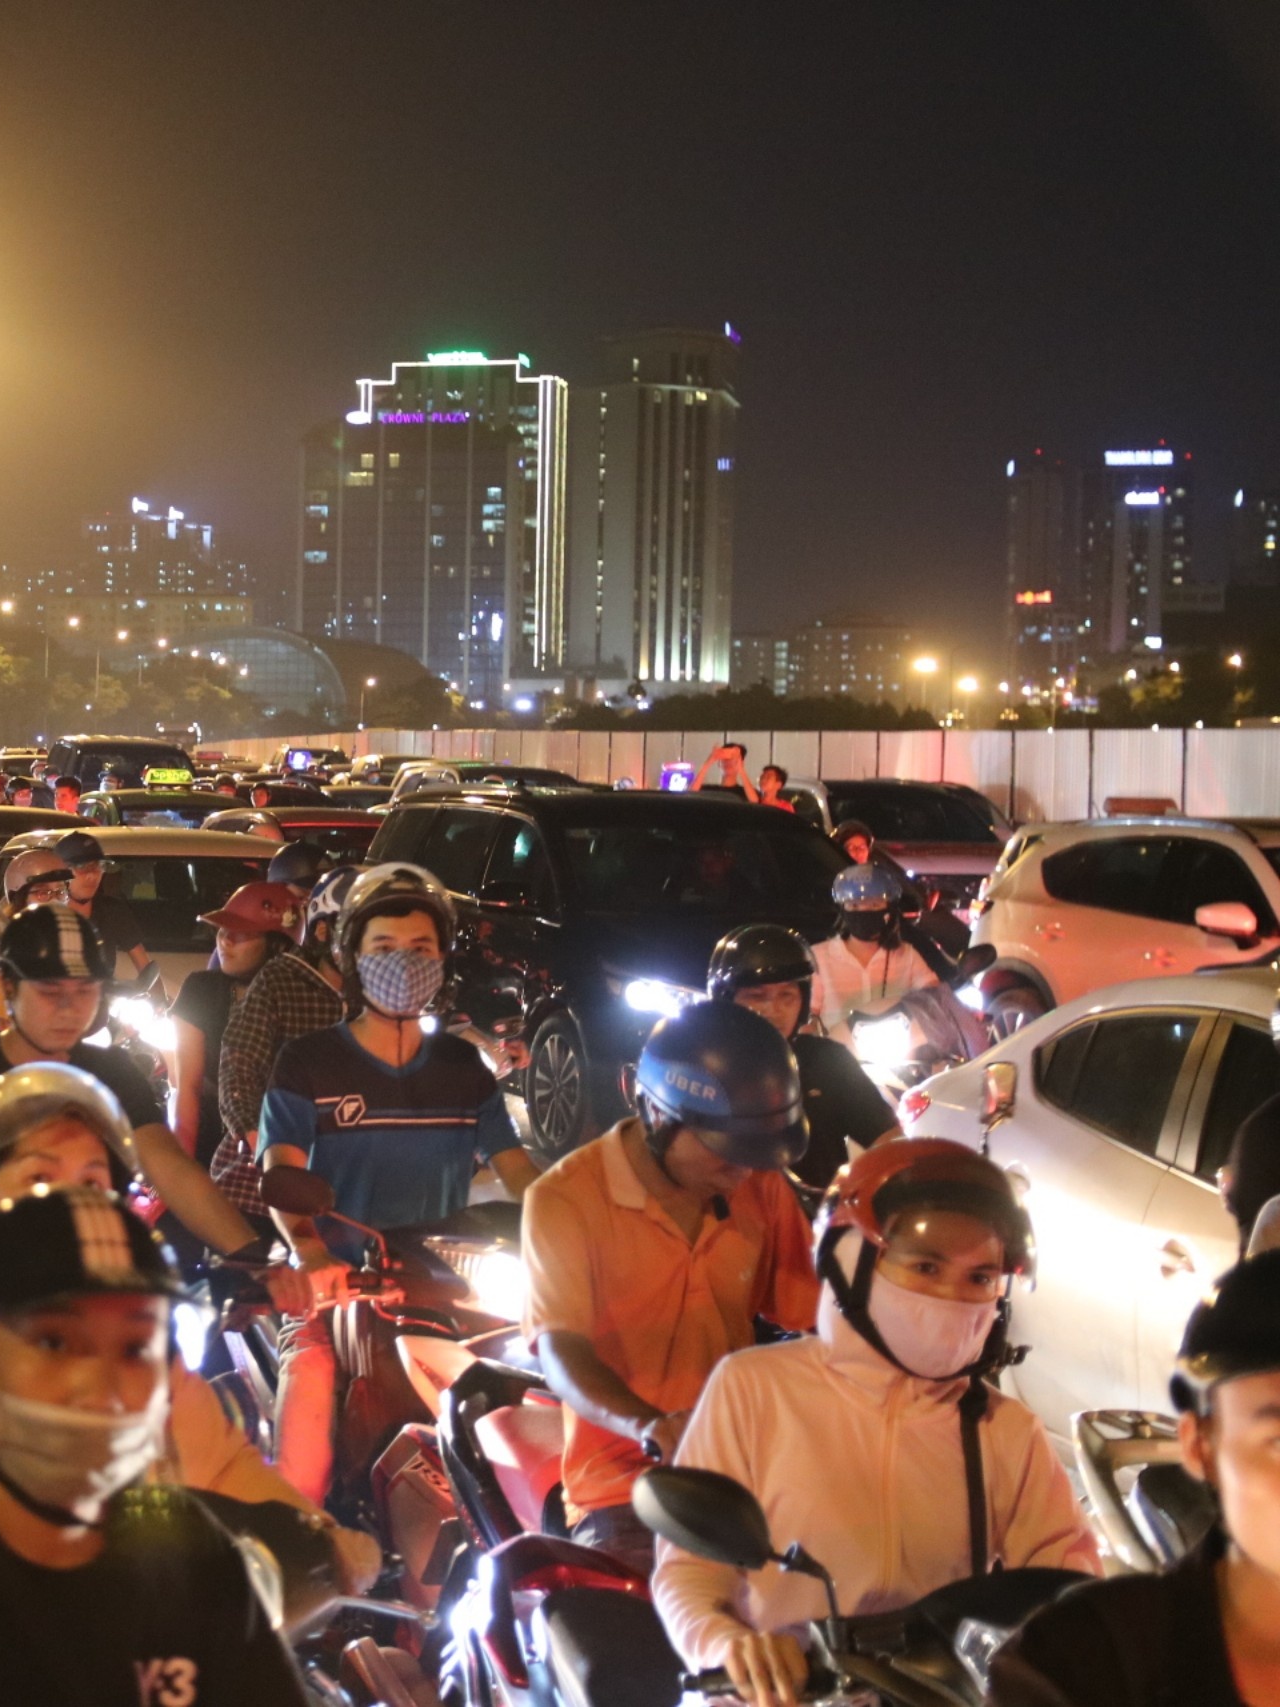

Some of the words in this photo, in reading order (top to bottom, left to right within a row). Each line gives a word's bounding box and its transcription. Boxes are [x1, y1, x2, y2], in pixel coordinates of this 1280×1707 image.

[381, 411, 424, 424] CROWNE
[431, 411, 466, 423] PLAZA
[664, 1070, 718, 1101] UBER
